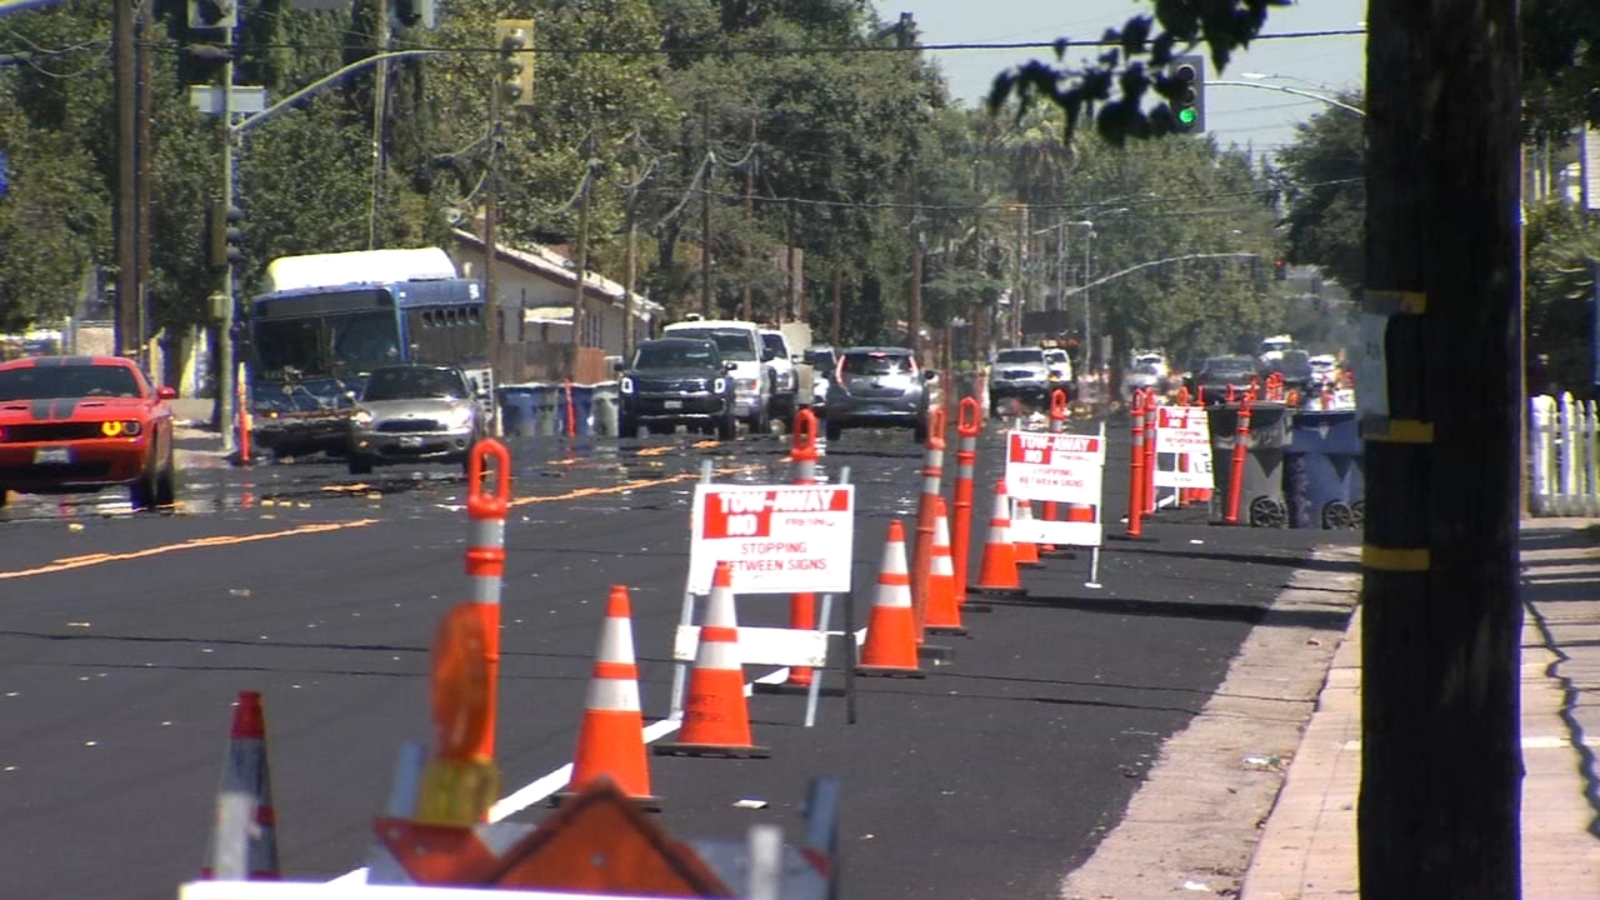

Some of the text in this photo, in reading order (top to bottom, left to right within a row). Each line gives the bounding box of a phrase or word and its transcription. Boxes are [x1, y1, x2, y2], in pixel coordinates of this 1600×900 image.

[1020, 434, 1090, 452] TOW-AWAY
[718, 490, 835, 513] TOW-AWAY
[727, 514, 758, 536] NO
[741, 541, 808, 555] STOPPING
[727, 558, 827, 572] ETWEEN SIGNS
